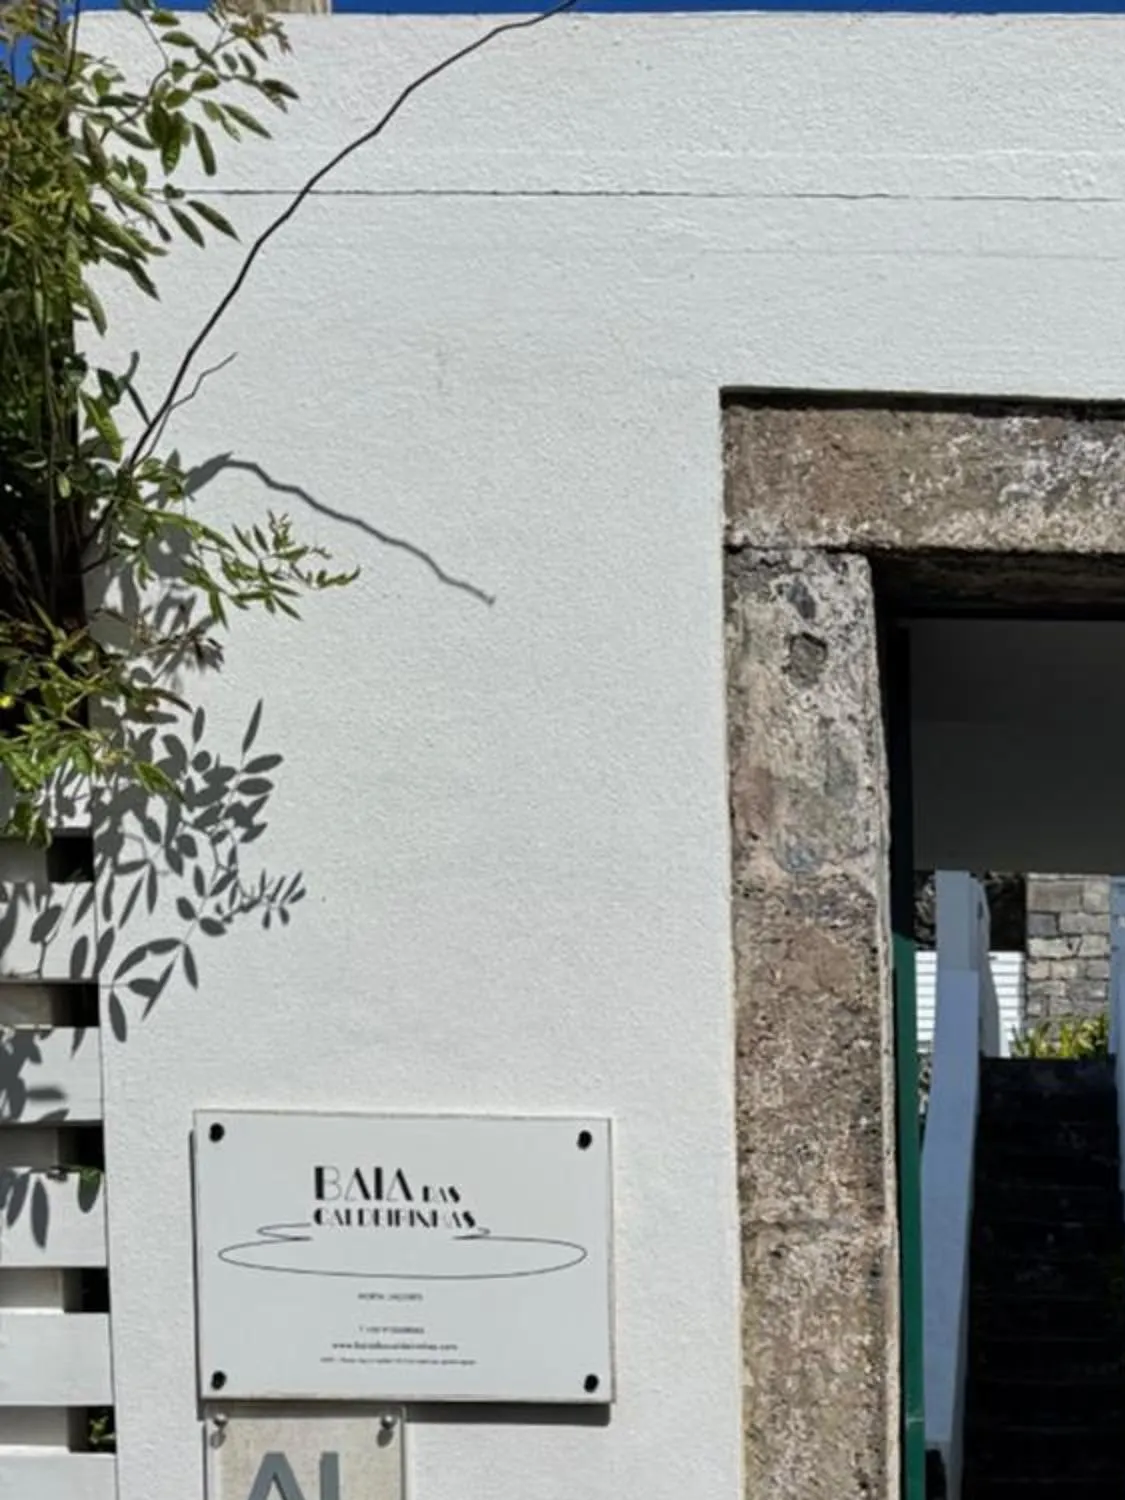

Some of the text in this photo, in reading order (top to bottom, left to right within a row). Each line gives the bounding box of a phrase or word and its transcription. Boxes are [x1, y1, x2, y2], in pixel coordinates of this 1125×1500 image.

[314, 1165, 461, 1204] BAIA DAS
[313, 1207, 477, 1229] CALDEIRINHAS
